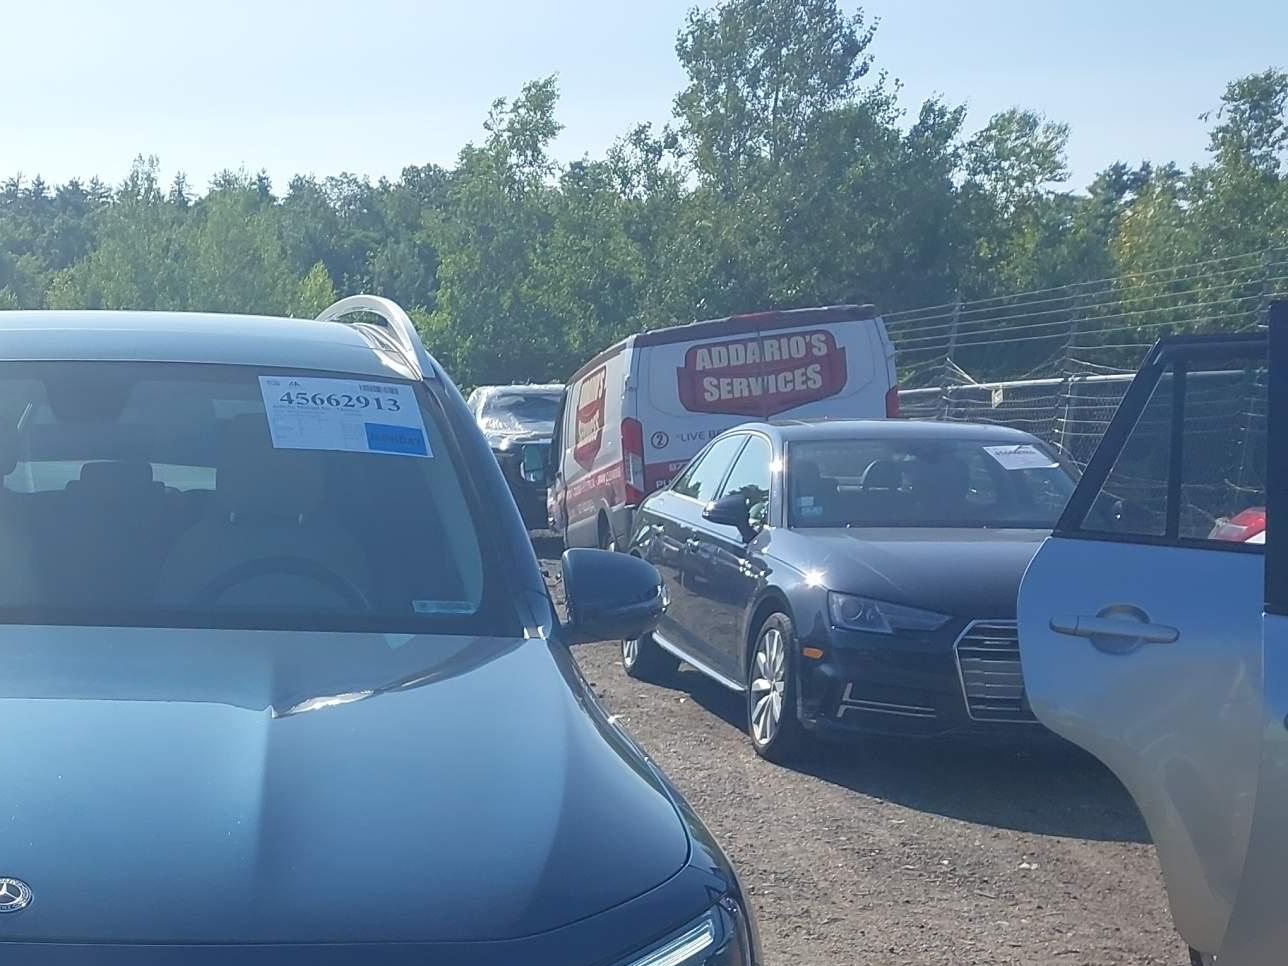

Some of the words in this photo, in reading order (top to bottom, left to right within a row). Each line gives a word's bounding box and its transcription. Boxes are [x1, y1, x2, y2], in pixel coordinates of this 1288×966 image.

[695, 333, 828, 371] ADDARIO'S
[279, 391, 401, 412] 45662913
[703, 363, 823, 402] SERVICES
